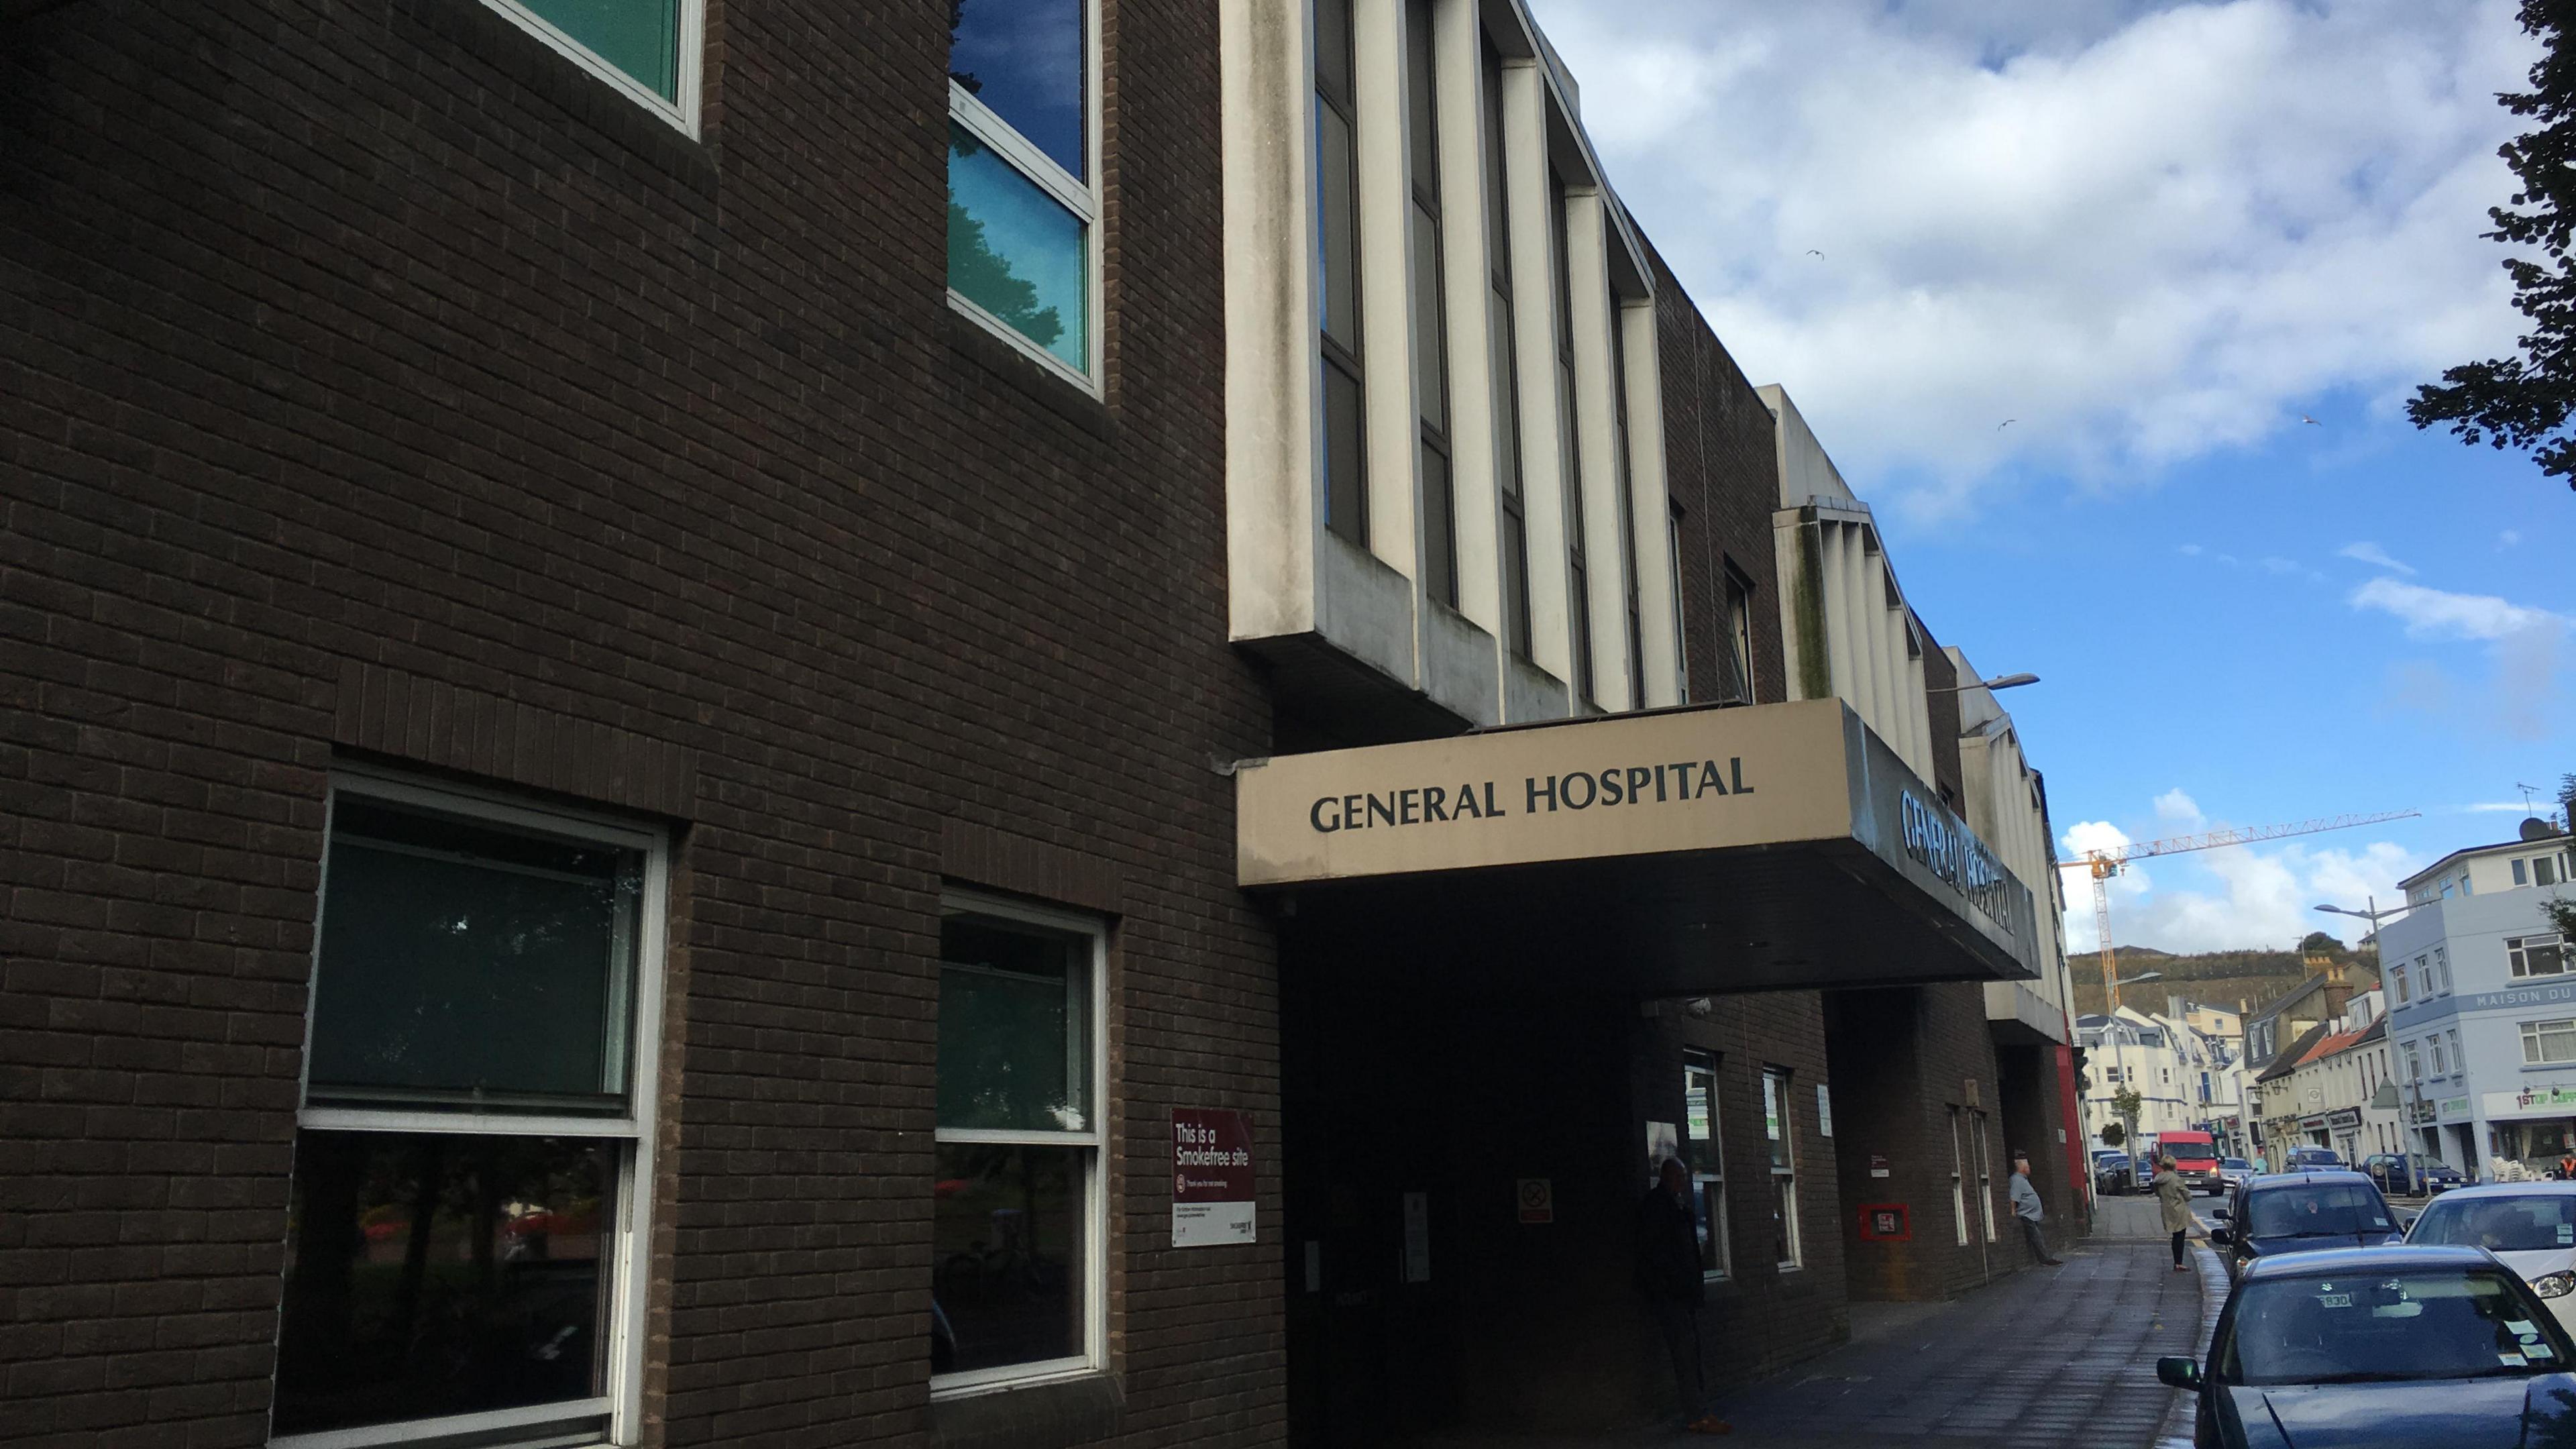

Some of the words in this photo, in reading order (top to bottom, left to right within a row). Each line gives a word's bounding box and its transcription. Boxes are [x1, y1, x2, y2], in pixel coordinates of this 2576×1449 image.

[1310, 782, 1505, 833] GENERAL
[1525, 757, 1754, 813] HOSPITAL
[2476, 991, 2540, 1006] MAISON
[2549, 987, 2571, 1000] DU
[1175, 1122, 1196, 1144] This
[1198, 1123, 1206, 1144] is
[1209, 1129, 1216, 1144] a
[1177, 1146, 1230, 1166] Smokefree
[1232, 1146, 1248, 1166] site
